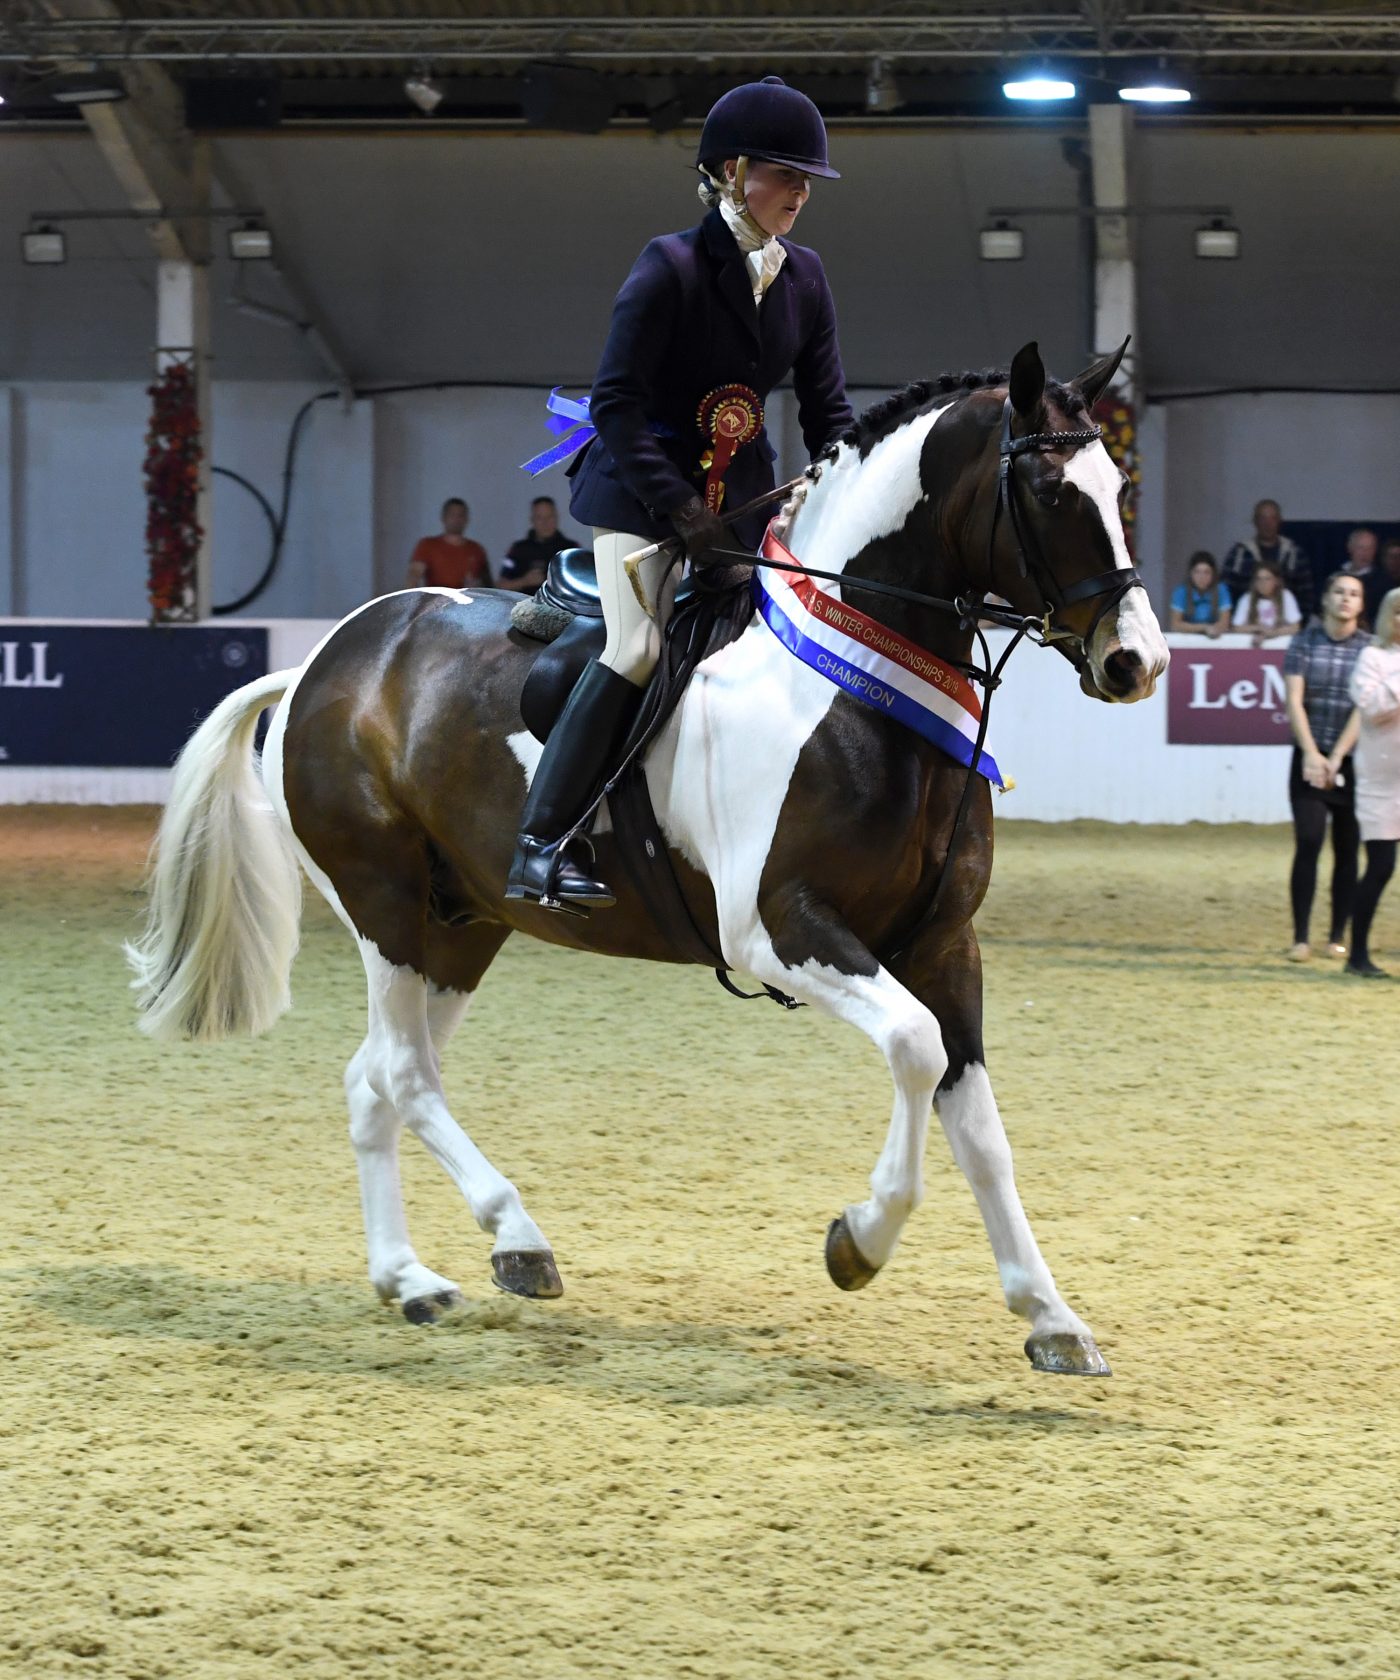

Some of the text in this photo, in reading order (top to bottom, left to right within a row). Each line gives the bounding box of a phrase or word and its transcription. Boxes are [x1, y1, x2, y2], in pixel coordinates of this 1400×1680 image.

[707, 483, 717, 512] CHA
[0, 641, 64, 688] LL
[825, 605, 863, 636] WINTER
[863, 628, 944, 683] CHAMPIONSHIPS
[942, 675, 959, 694] 2019
[816, 654, 895, 708] CHAMPION
